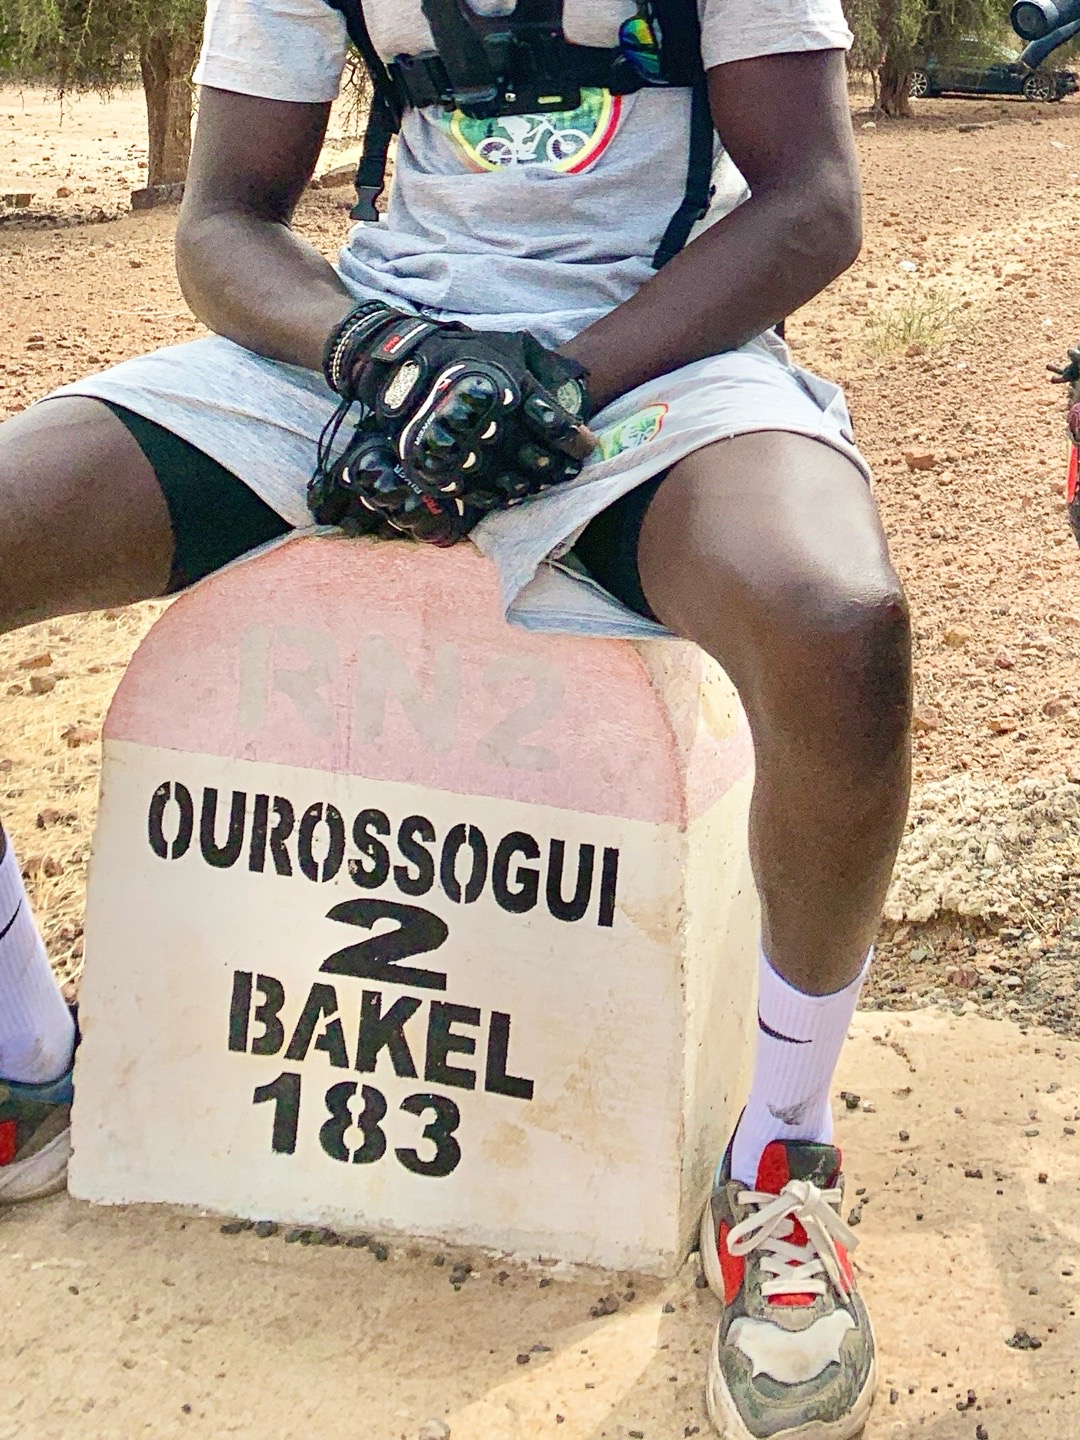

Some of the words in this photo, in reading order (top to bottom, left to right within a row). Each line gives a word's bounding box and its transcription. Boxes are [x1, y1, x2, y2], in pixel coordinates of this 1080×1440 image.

[236, 622, 566, 772] RN2
[148, 780, 620, 928] OUROSSOGUI
[318, 898, 449, 991] 2
[228, 970, 535, 1101] BAKEL
[253, 1072, 462, 1177] 183
